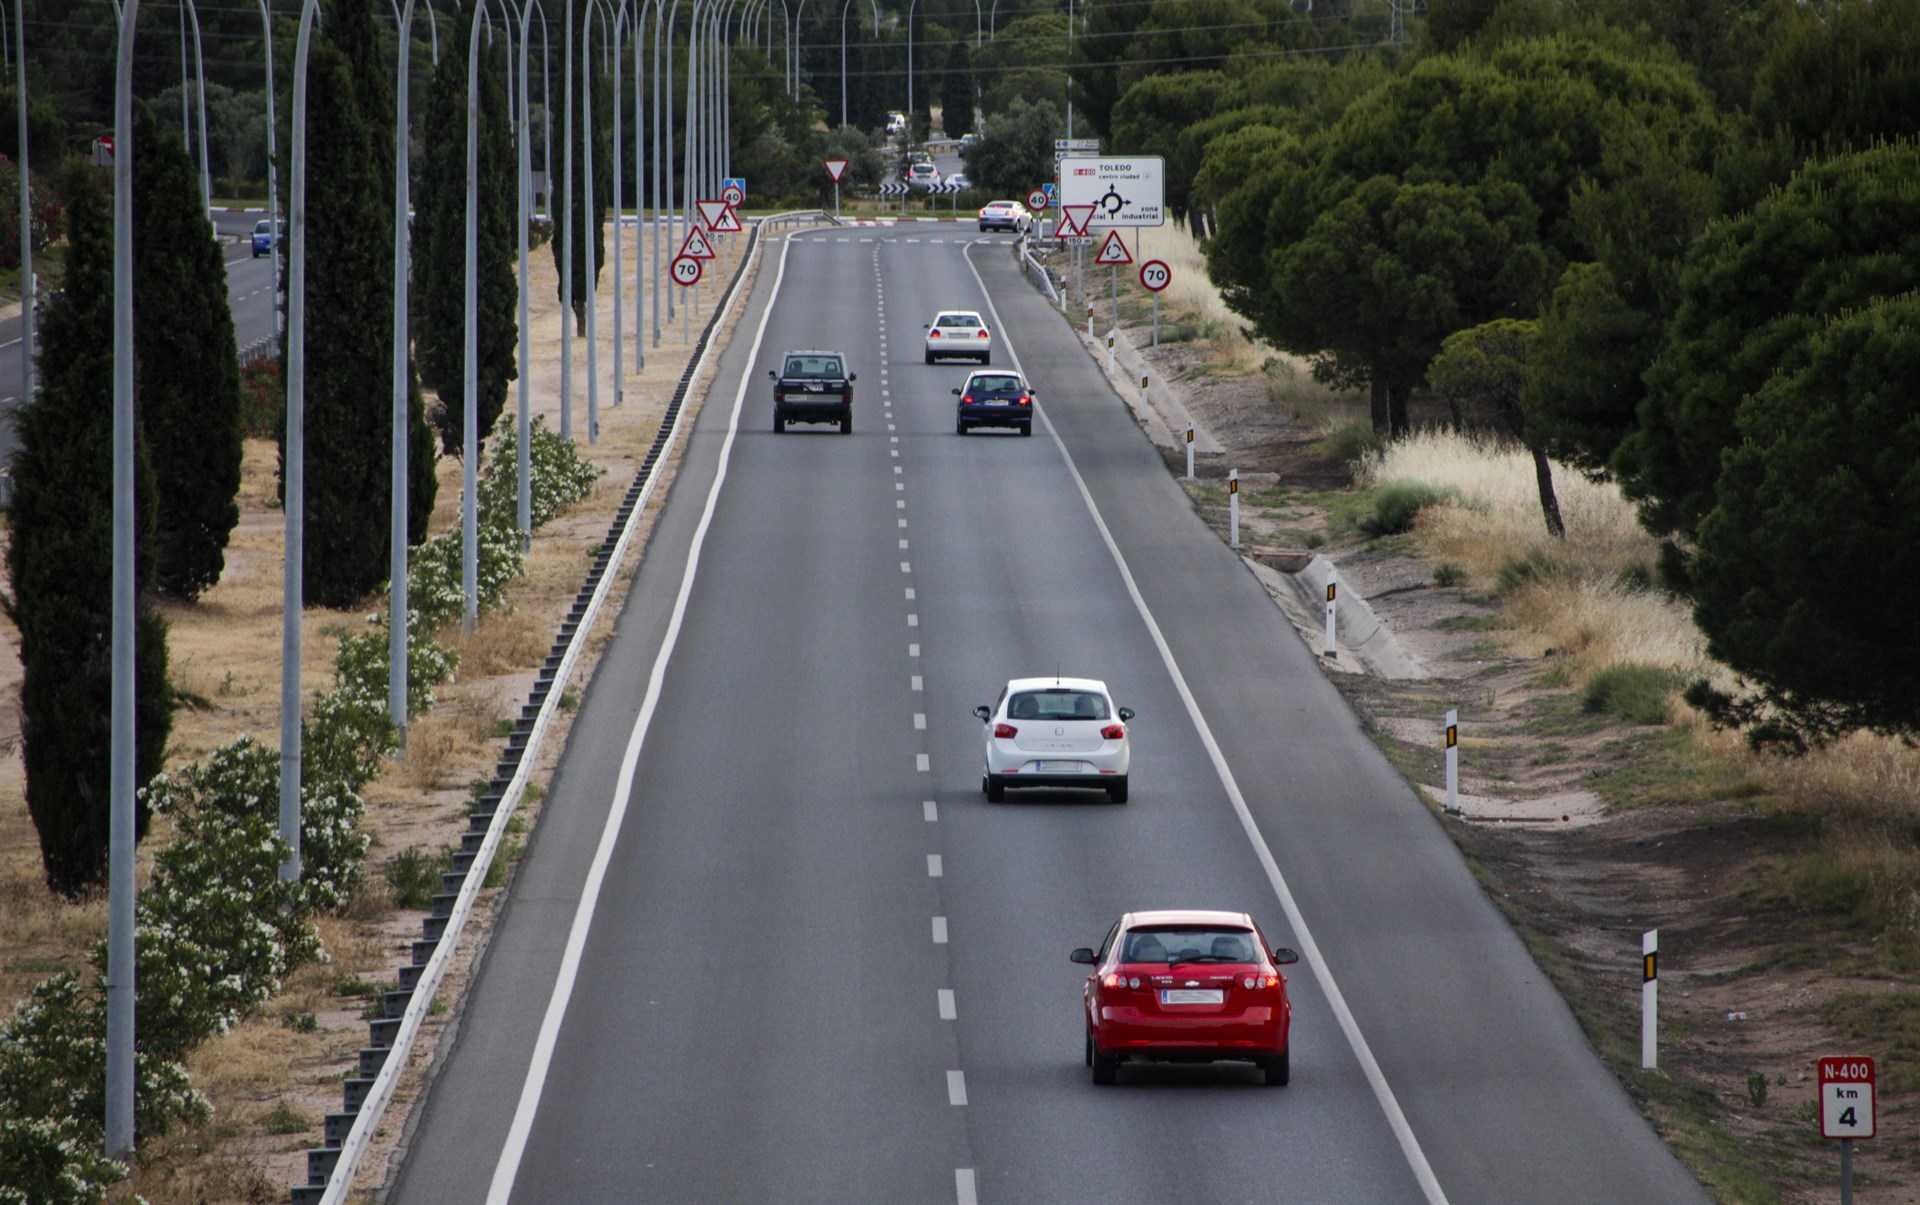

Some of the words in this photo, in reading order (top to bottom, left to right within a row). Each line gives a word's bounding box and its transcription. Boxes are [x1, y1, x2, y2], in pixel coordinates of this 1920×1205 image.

[1099, 164, 1132, 172] TOLEDO
[726, 193, 739, 201] 40
[1031, 196, 1044, 204] 40
[678, 264, 696, 276] 70
[1147, 270, 1165, 281] 70
[1824, 1063, 1869, 1079] N-400
[1836, 1087, 1858, 1099] km
[1838, 1106, 1858, 1127] 4
